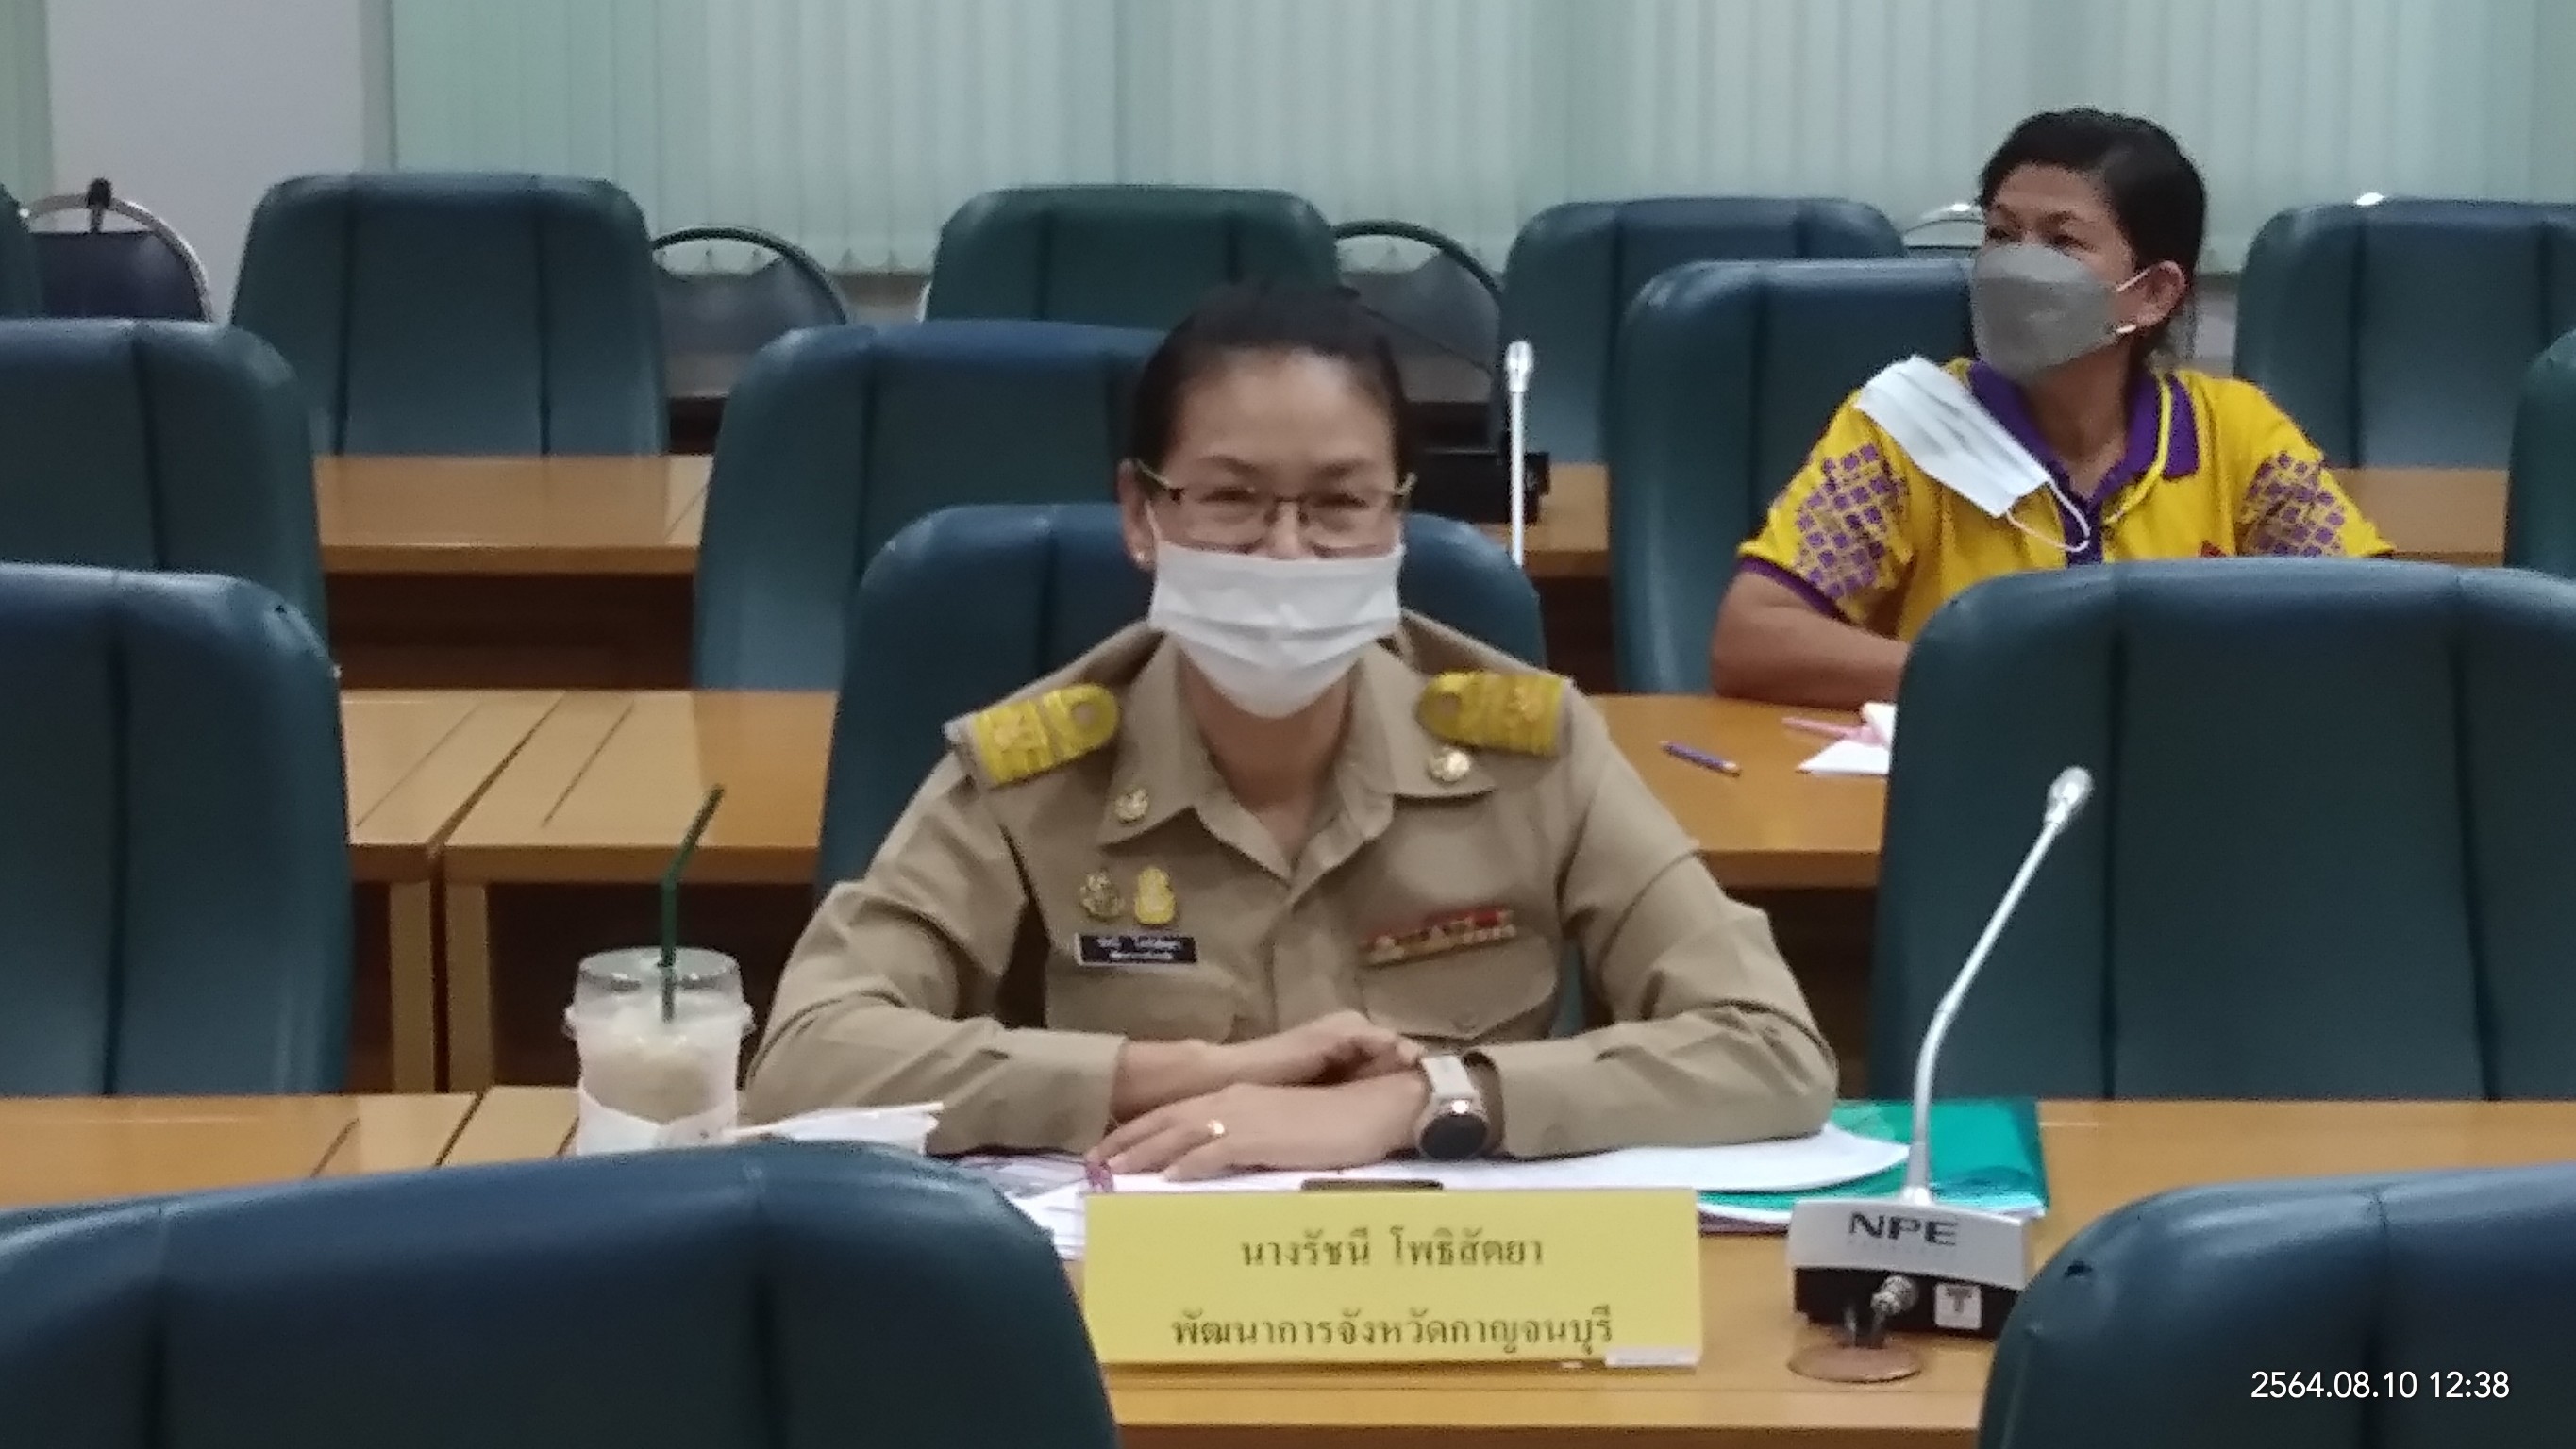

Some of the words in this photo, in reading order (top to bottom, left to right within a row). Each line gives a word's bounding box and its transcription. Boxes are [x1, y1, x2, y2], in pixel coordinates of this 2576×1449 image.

[1241, 1226, 1371, 1266] นางรัชนี
[1848, 1211, 1959, 1246] NPE
[1172, 1304, 1614, 1356] พัฒนาการจังหวัดกาญจนบุรี
